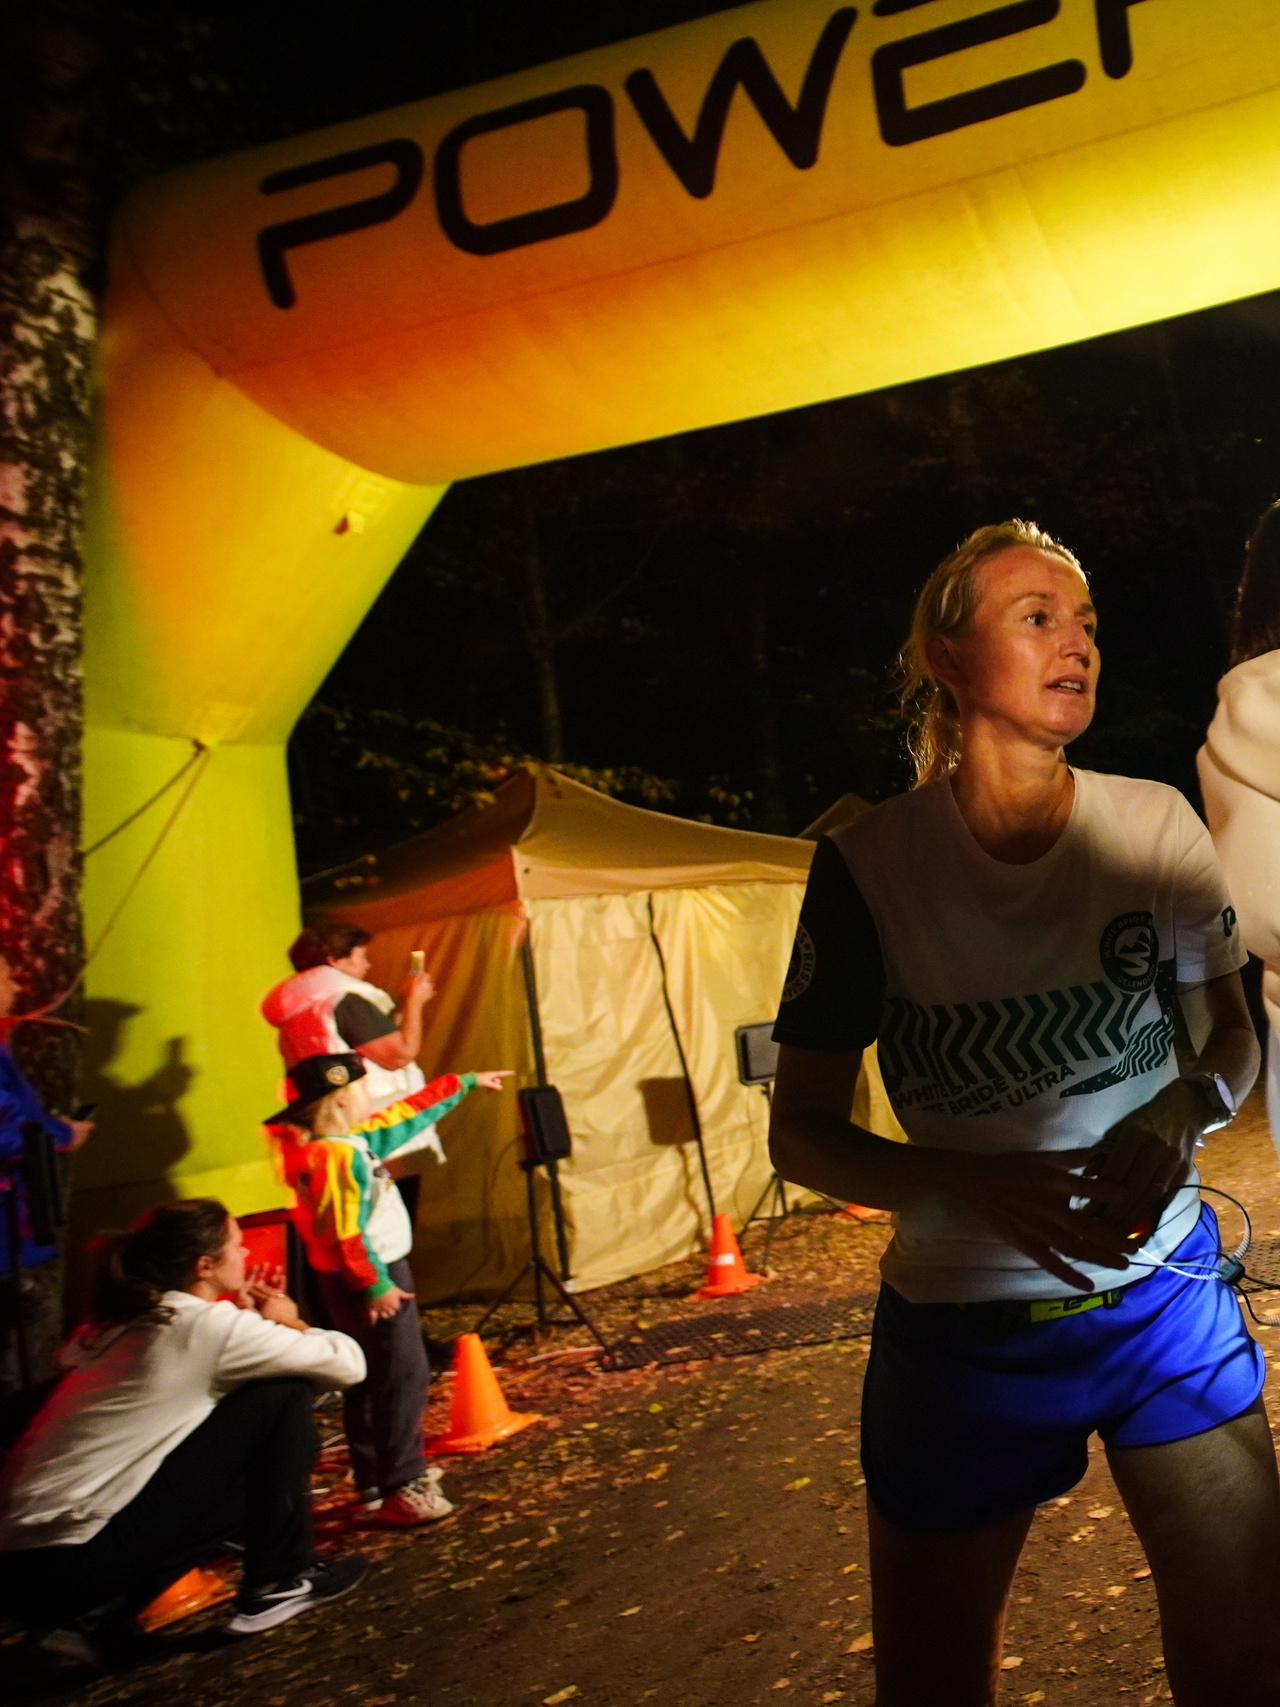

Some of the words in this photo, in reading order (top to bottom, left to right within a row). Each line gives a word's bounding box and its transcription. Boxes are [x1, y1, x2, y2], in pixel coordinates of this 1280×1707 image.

[890, 1083, 948, 1110] WHITE
[944, 1076, 1010, 1116] BRIDE
[1006, 1063, 1076, 1108] ULTRA
